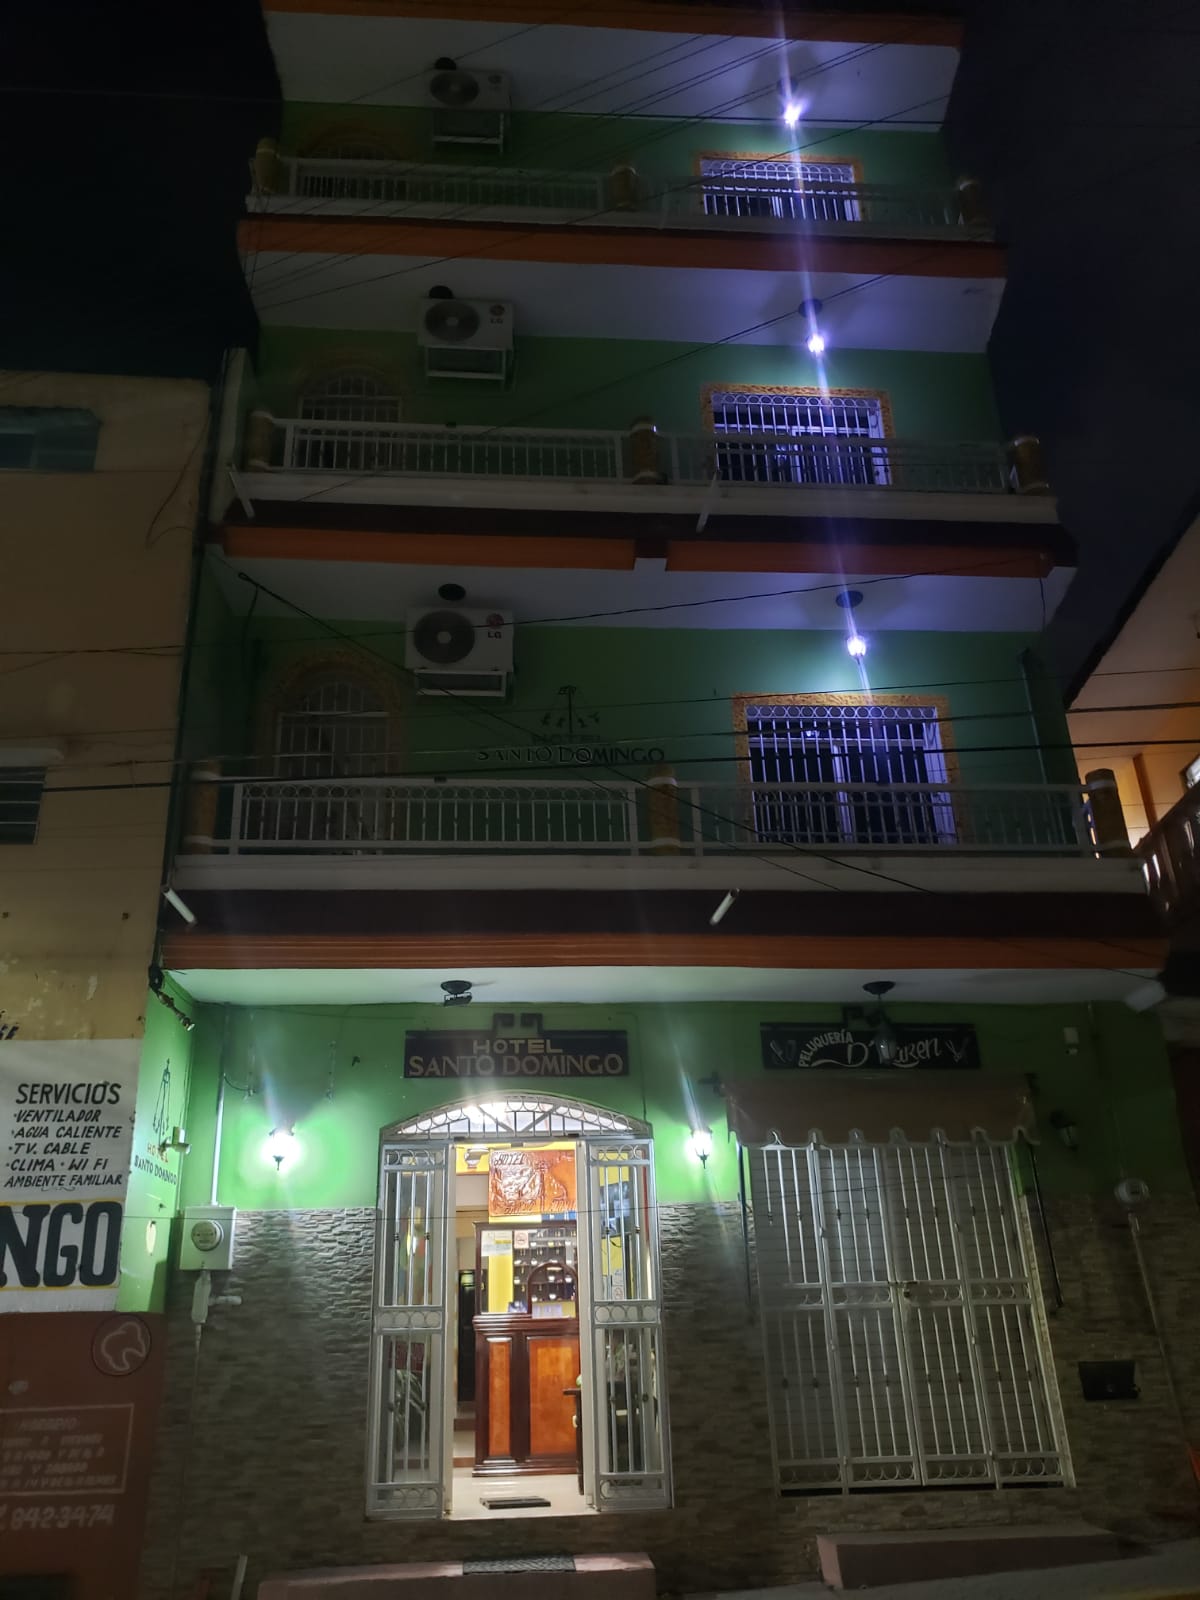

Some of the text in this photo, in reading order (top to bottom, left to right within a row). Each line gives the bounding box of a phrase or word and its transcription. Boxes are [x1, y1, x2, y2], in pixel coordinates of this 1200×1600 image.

[487, 631, 502, 639] LG
[478, 746, 665, 764] SANTO DOMINGO
[472, 1039, 563, 1054] HOTEL
[408, 1053, 624, 1077] SANTO DOMINGO
[16, 1109, 102, 1122] VENTILADOR
[14, 1126, 122, 1138] AGUA CALIENTE
[43, 1142, 91, 1155] CABLE
[10, 1158, 55, 1172] CLIMA
[134, 1154, 154, 1174] SANTO
[4, 1174, 123, 1188] AMBIENTE FAMILIAR
